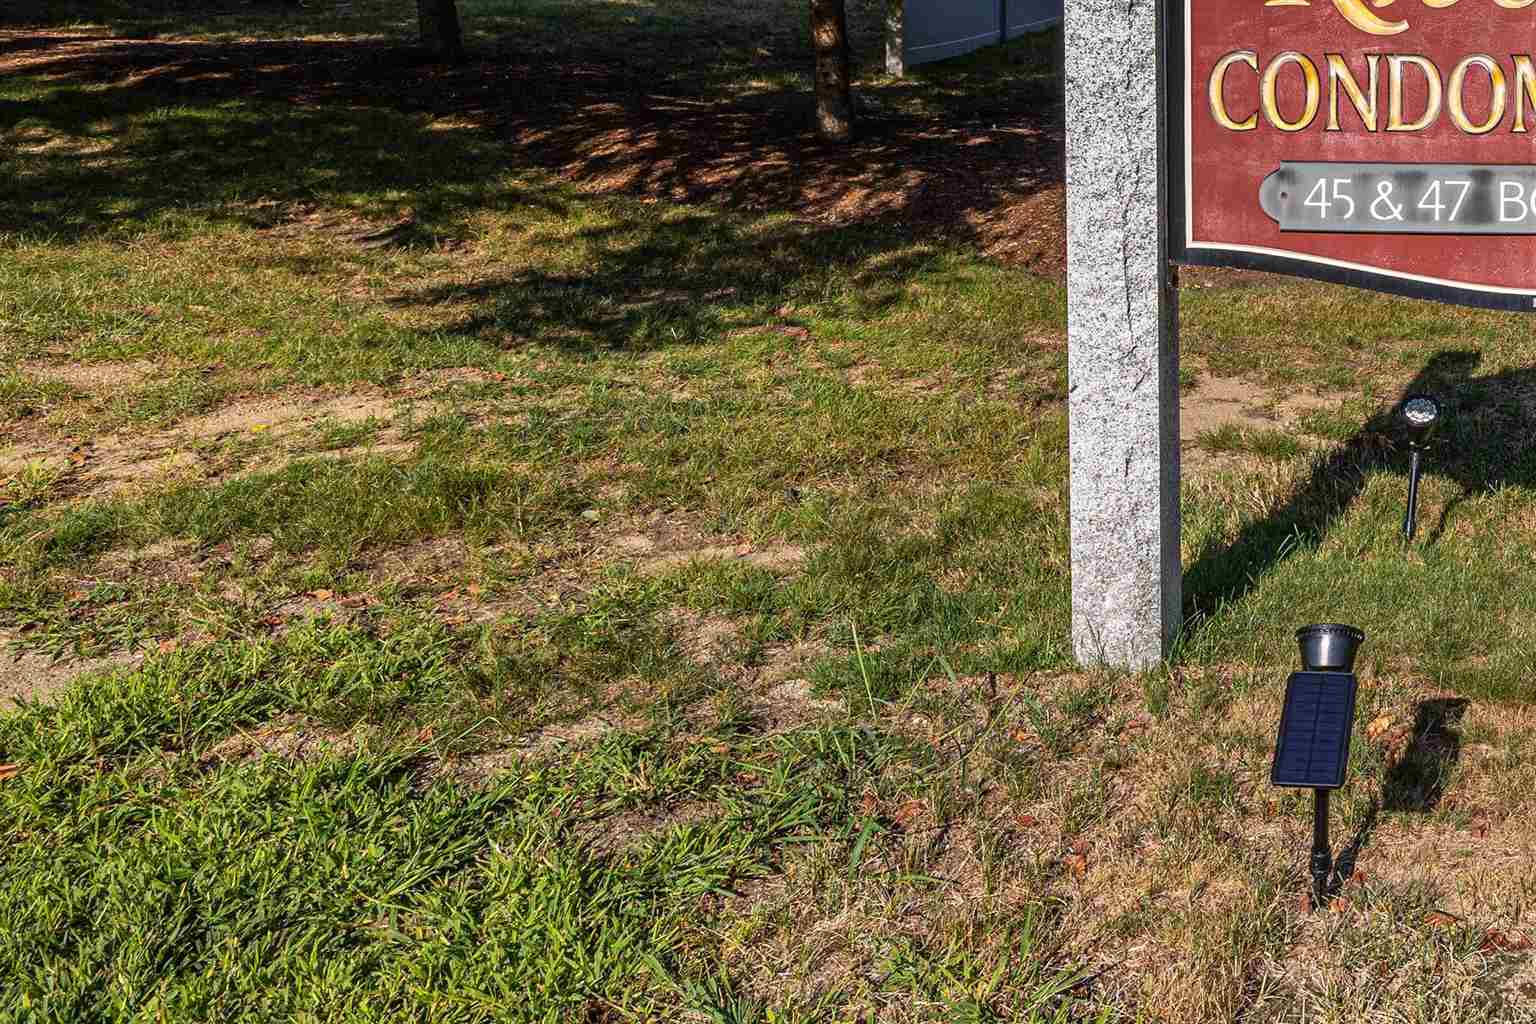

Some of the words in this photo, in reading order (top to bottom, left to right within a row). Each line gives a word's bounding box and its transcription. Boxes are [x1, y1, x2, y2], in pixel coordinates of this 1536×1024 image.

[1303, 177, 1355, 221] 45
[1369, 181, 1403, 222] &
[1416, 179, 1471, 221] 47
